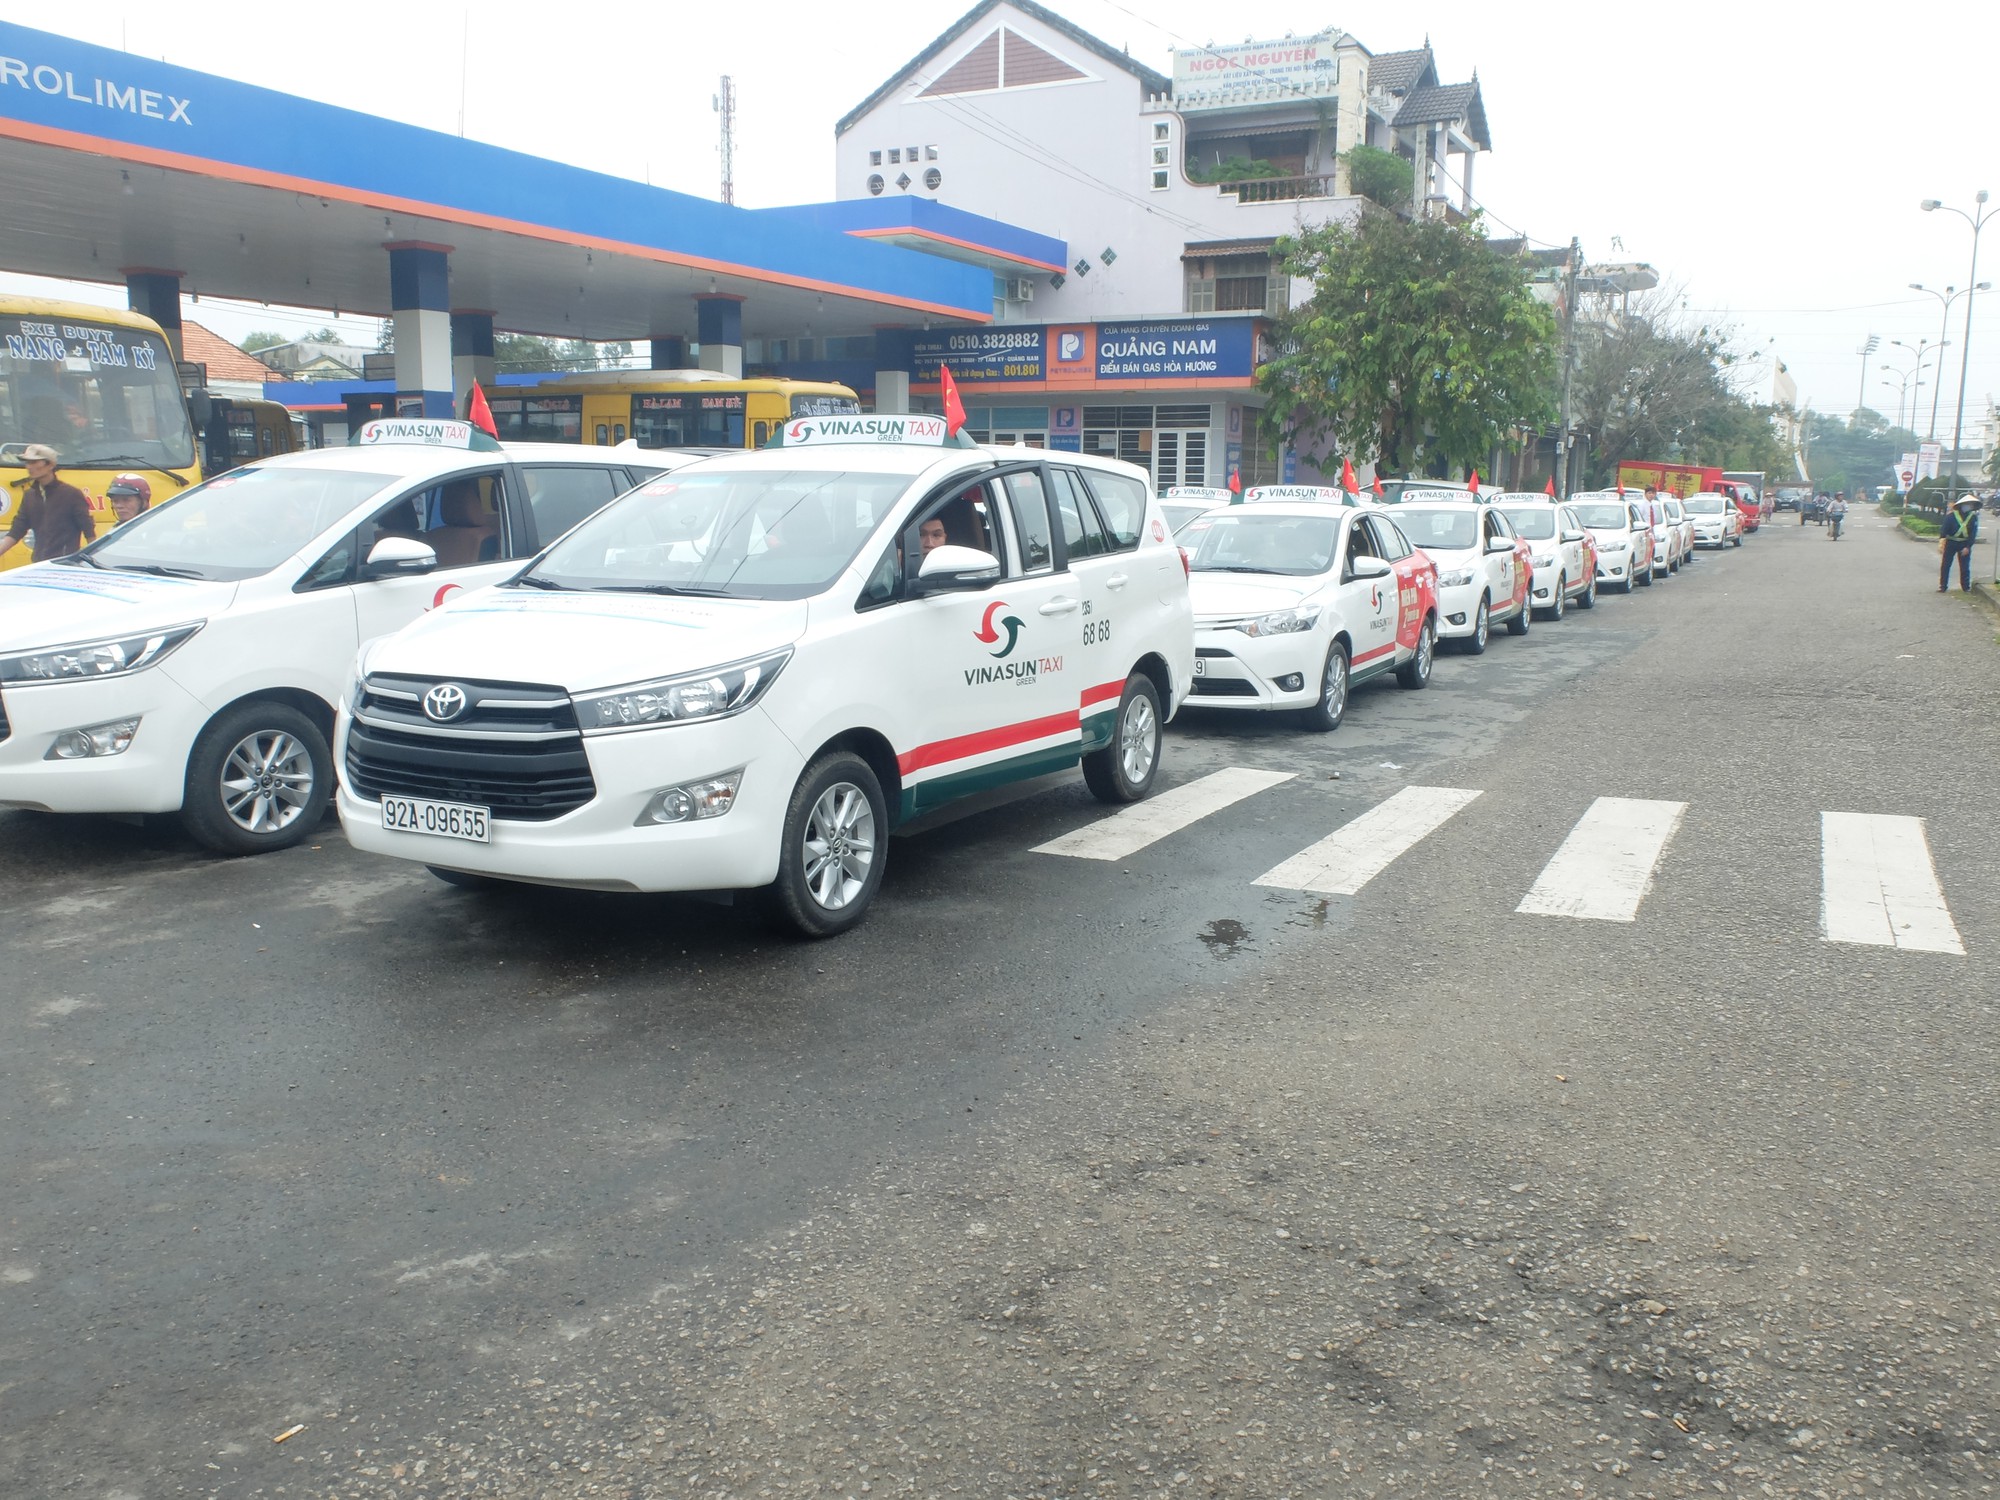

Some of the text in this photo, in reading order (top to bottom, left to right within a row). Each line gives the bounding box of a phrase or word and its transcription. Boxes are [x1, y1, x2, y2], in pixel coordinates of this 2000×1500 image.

[0, 56, 193, 126] ROLIMEX
[30, 322, 57, 337] XE
[949, 332, 1039, 350] 0510.3828882
[1101, 336, 1217, 359] QUẢNG NAM
[86, 340, 128, 367] TAM
[131, 340, 156, 370] KỲ
[1003, 364, 1039, 376] 801.801
[1100, 360, 1217, 374] ĐIỂM BÁN GAS HÒA HƯƠNG
[386, 424, 467, 439] VINASUN TAXI
[819, 420, 941, 437] VINASUN TAXI
[877, 434, 903, 442] GREEN
[1183, 488, 1216, 496] VINASUN
[1269, 488, 1341, 499] VINASUN TAXI
[1455, 491, 1472, 499] TAXI
[964, 655, 1064, 686] VINASUN TAXI
[1016, 677, 1037, 686] GREEN
[385, 800, 486, 838] 92A-096.55
